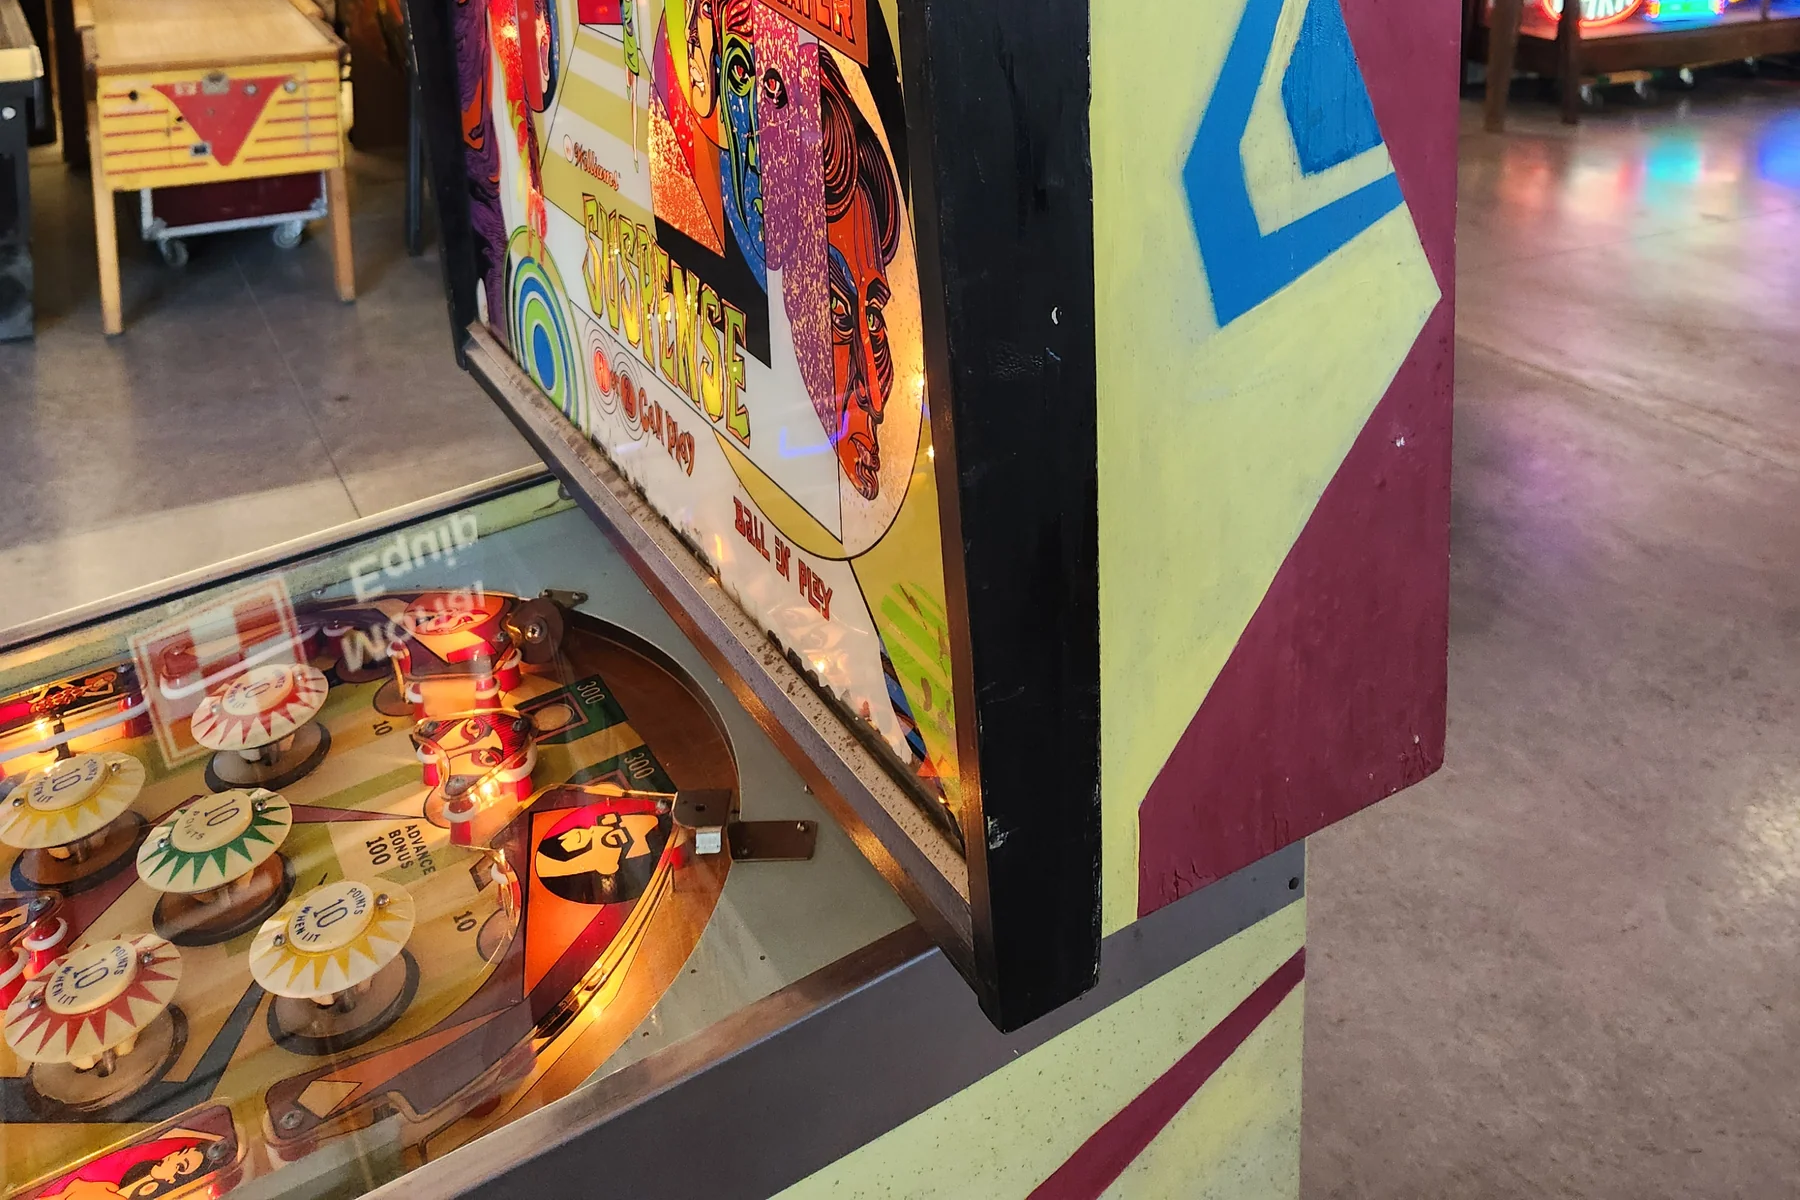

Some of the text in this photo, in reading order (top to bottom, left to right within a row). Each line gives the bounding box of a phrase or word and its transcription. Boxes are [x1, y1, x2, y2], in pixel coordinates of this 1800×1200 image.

[582, 192, 751, 450] SUSPENSE
[243, 680, 271, 699] 10
[576, 680, 605, 706] 300
[372, 720, 393, 736] 10
[52, 768, 82, 792] 10
[624, 752, 656, 780] 300
[184, 810, 205, 841] POINTS
[204, 799, 240, 827] 10
[365, 835, 392, 866] 100
[388, 828, 415, 870] BONUS
[405, 823, 437, 876] ADVANCE
[313, 898, 349, 928] 10
[347, 887, 367, 915] POINTS
[294, 906, 314, 936] WHEN
[453, 910, 478, 933] 10
[73, 957, 110, 989] 10
[111, 945, 128, 975] POINTS
[52, 966, 75, 997] WHEN
